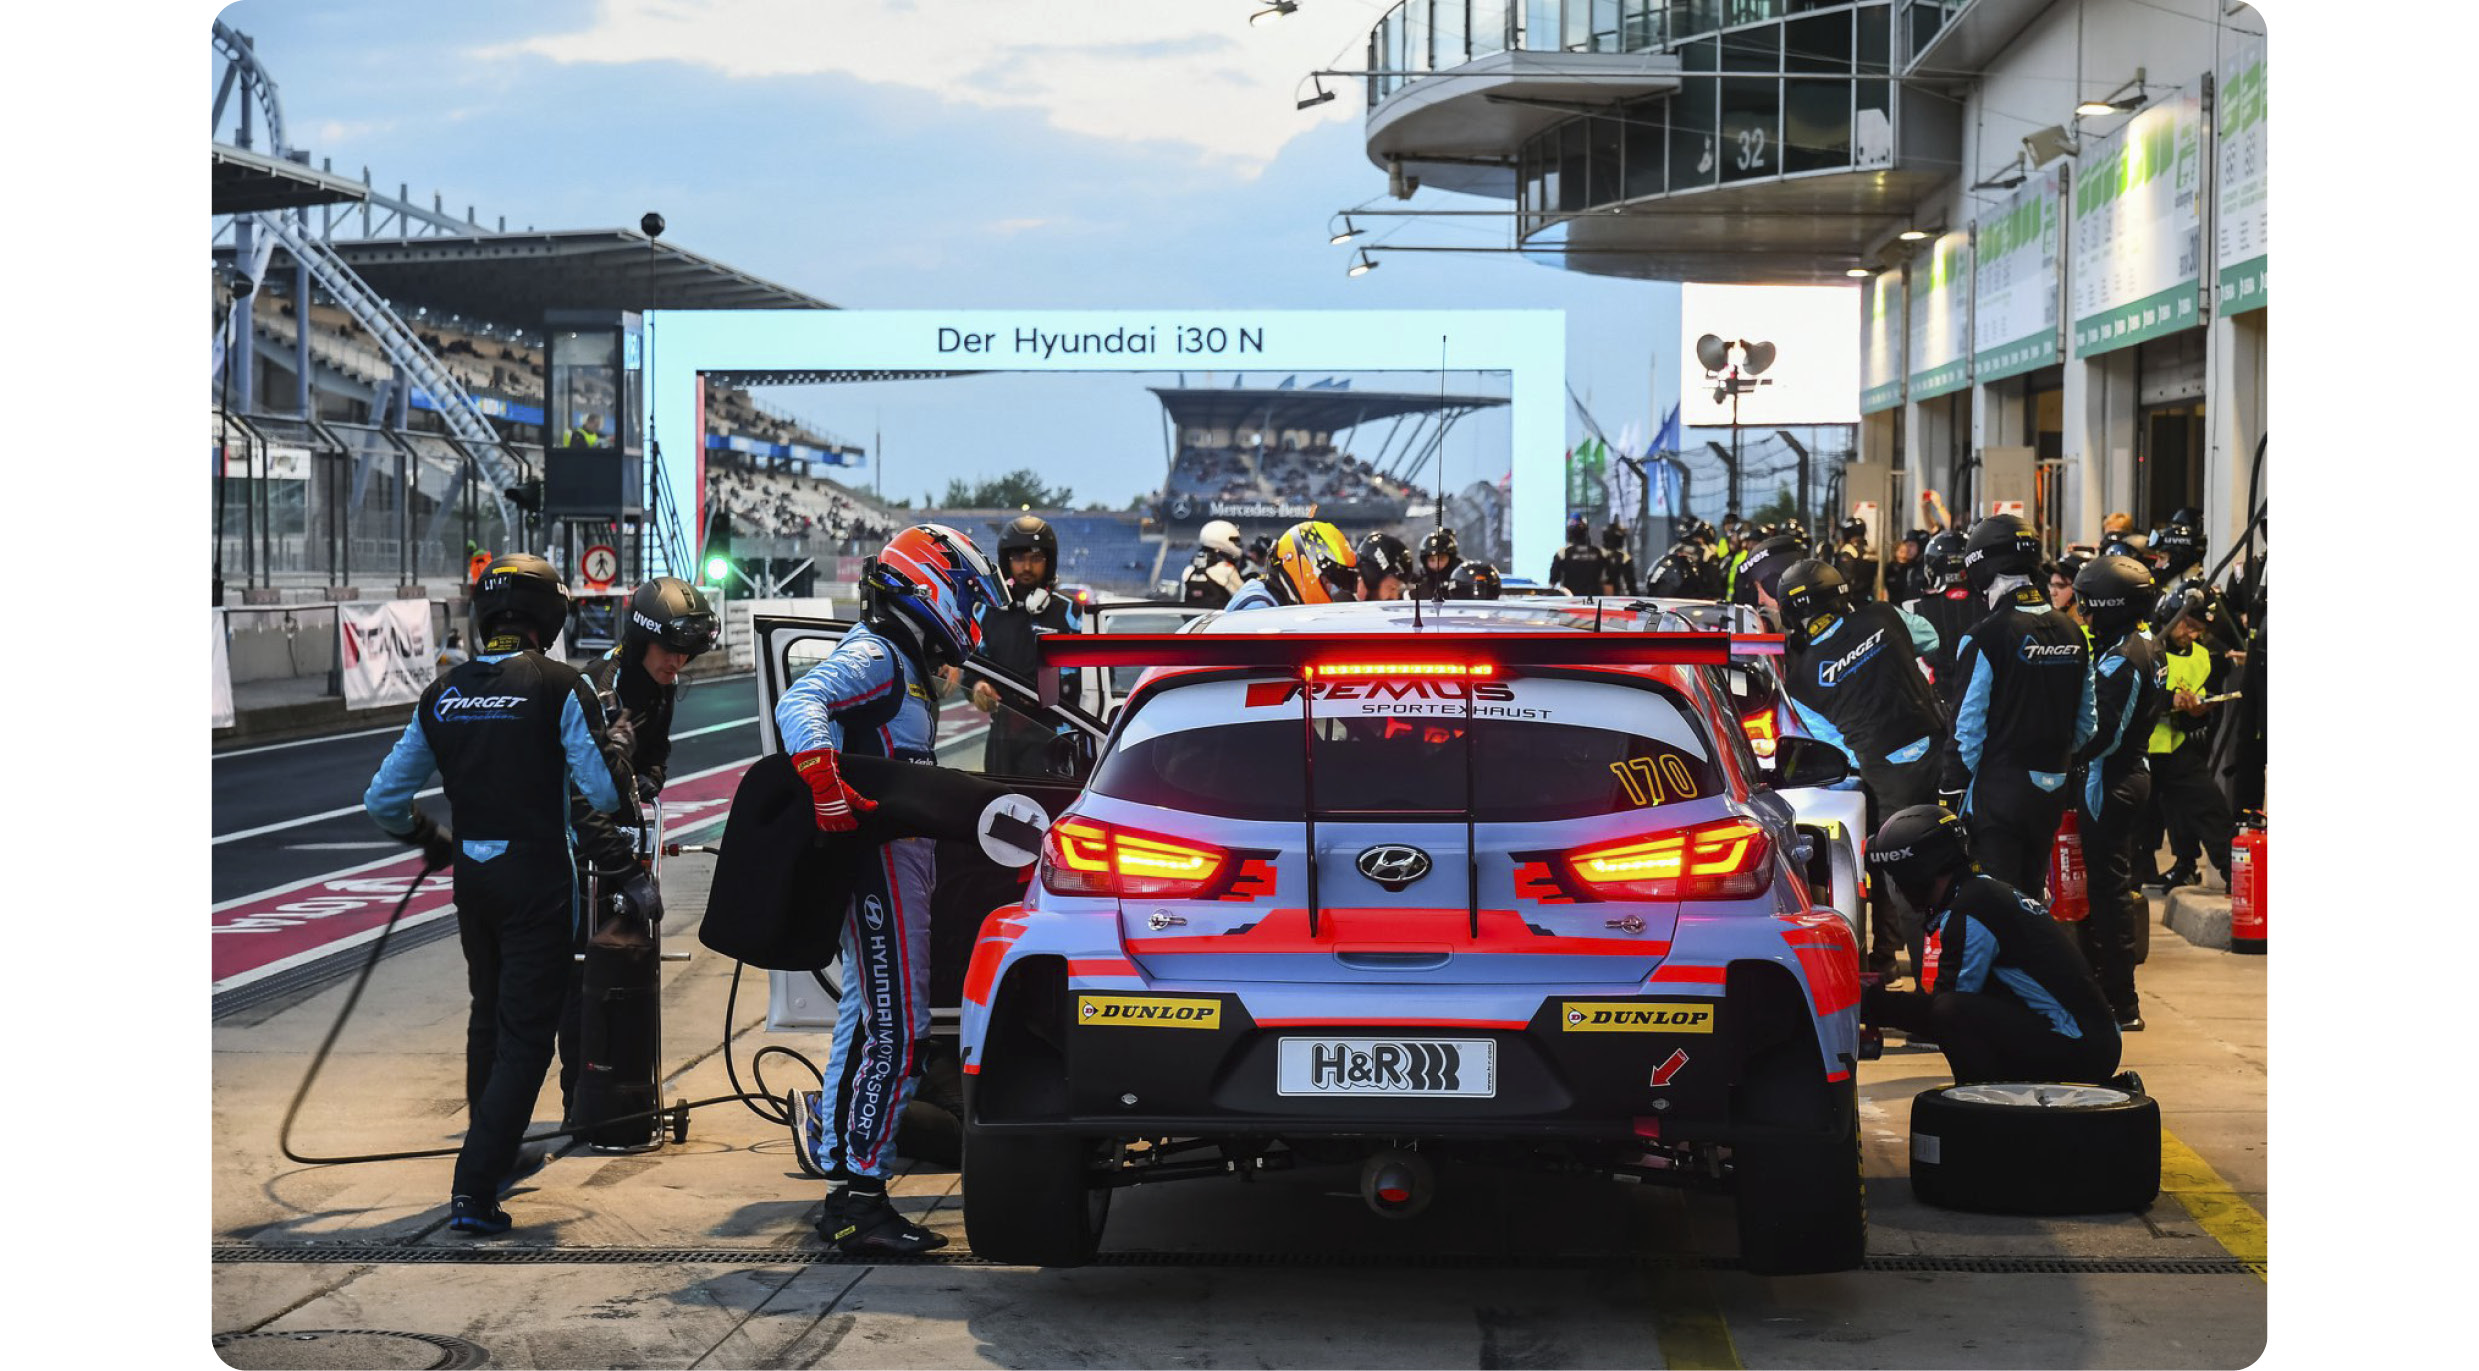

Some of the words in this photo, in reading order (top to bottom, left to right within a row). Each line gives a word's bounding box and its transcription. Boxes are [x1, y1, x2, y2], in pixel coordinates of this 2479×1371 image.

[1736, 127, 1765, 171] 32
[937, 326, 996, 353] Der
[1014, 324, 1156, 360] Hyundai
[1176, 324, 1227, 354] i30
[1239, 326, 1264, 354] N
[1738, 548, 1770, 575] uvex
[2088, 596, 2126, 609] uvex
[632, 609, 663, 635] uvex
[1821, 627, 1886, 683] TARGET
[2024, 644, 2081, 660] TARGET
[1283, 680, 1516, 702] REMUS
[440, 695, 529, 715] TARGET
[1608, 753, 1698, 806] 170
[1869, 845, 1915, 864] uvex
[869, 935, 893, 1030] HYUNDAI
[1100, 1004, 1215, 1021] DUNLOP
[1590, 1010, 1709, 1025] DUNLOP
[1312, 1042, 1410, 1090] H&R
